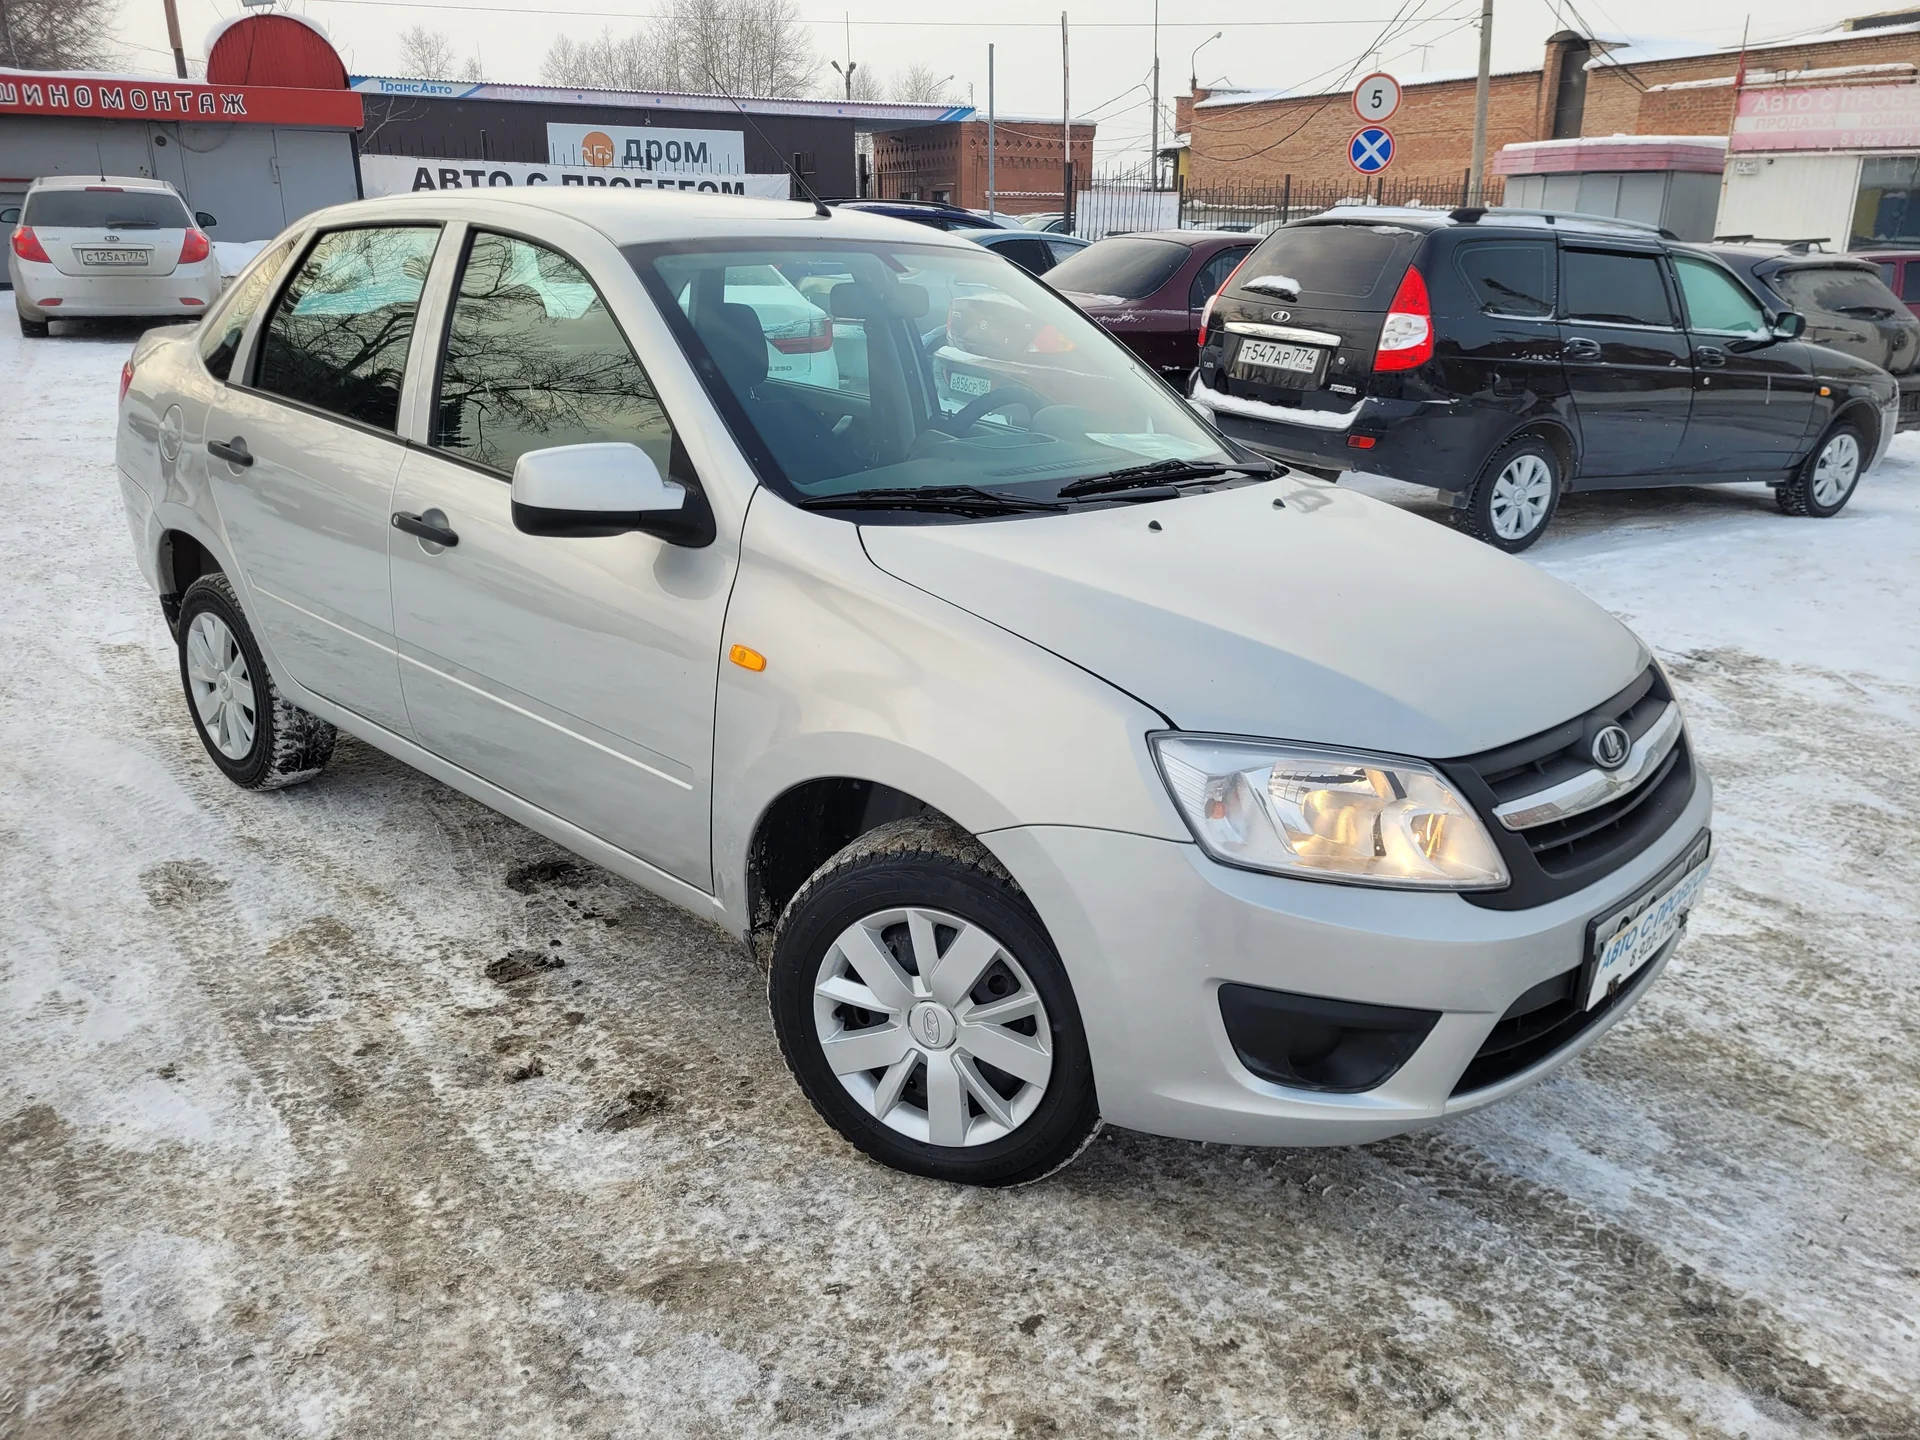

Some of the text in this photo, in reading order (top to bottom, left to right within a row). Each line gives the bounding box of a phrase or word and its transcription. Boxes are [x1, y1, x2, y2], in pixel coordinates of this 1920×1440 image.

[0, 82, 247, 115] ШИНОМОНТАЖ
[379, 80, 453, 96] ТрансАвто
[1371, 89, 1383, 109] 5
[496, 87, 929, 119] ПРОДАЖА ВЫКУП КРЕДИТЫ ДОГОВОРЫ СТРАХОВАНИЕ
[1753, 92, 1812, 113] АВТО
[1820, 92, 1834, 109] С
[1755, 115, 1836, 131] ПРОДАЖА
[1853, 132, 1881, 145] 922
[411, 167, 514, 192] АВТО
[1243, 343, 1315, 366] Т547АР 774
[1601, 926, 1638, 970] АВТО
[1641, 913, 1653, 939] С
